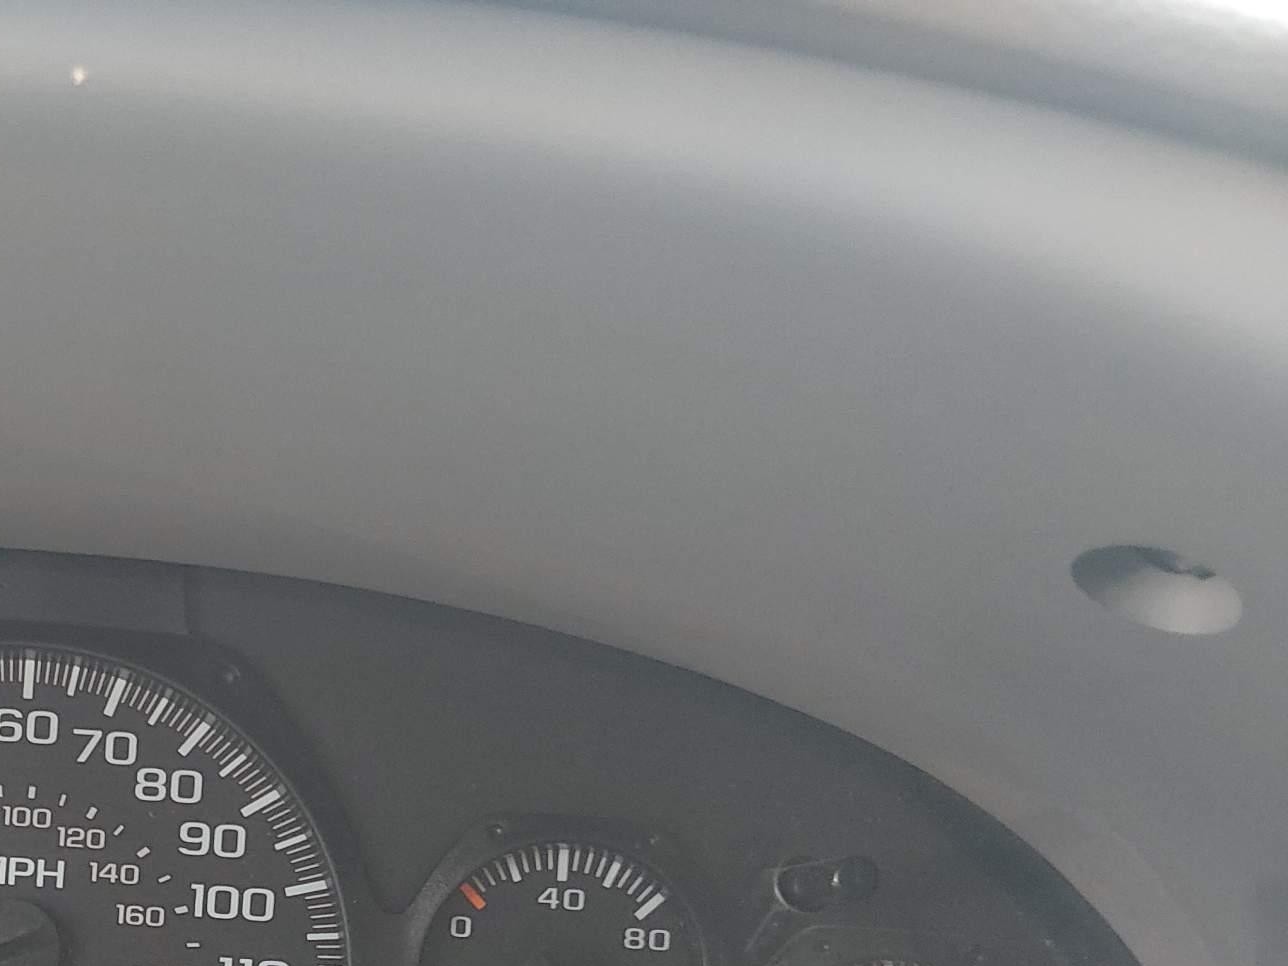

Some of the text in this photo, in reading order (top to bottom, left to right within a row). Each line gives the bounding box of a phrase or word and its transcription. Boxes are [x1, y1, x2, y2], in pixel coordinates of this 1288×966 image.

[73, 729, 137, 764] 70
[135, 768, 202, 803] 80
[3, 806, 51, 828] 100
[58, 827, 105, 848] 120
[179, 822, 245, 857] 90
[90, 862, 139, 884] 140
[191, 884, 274, 921] 100
[538, 888, 584, 910] 40
[116, 904, 164, 926] 160
[451, 917, 471, 937] 0
[624, 928, 670, 950] 80
